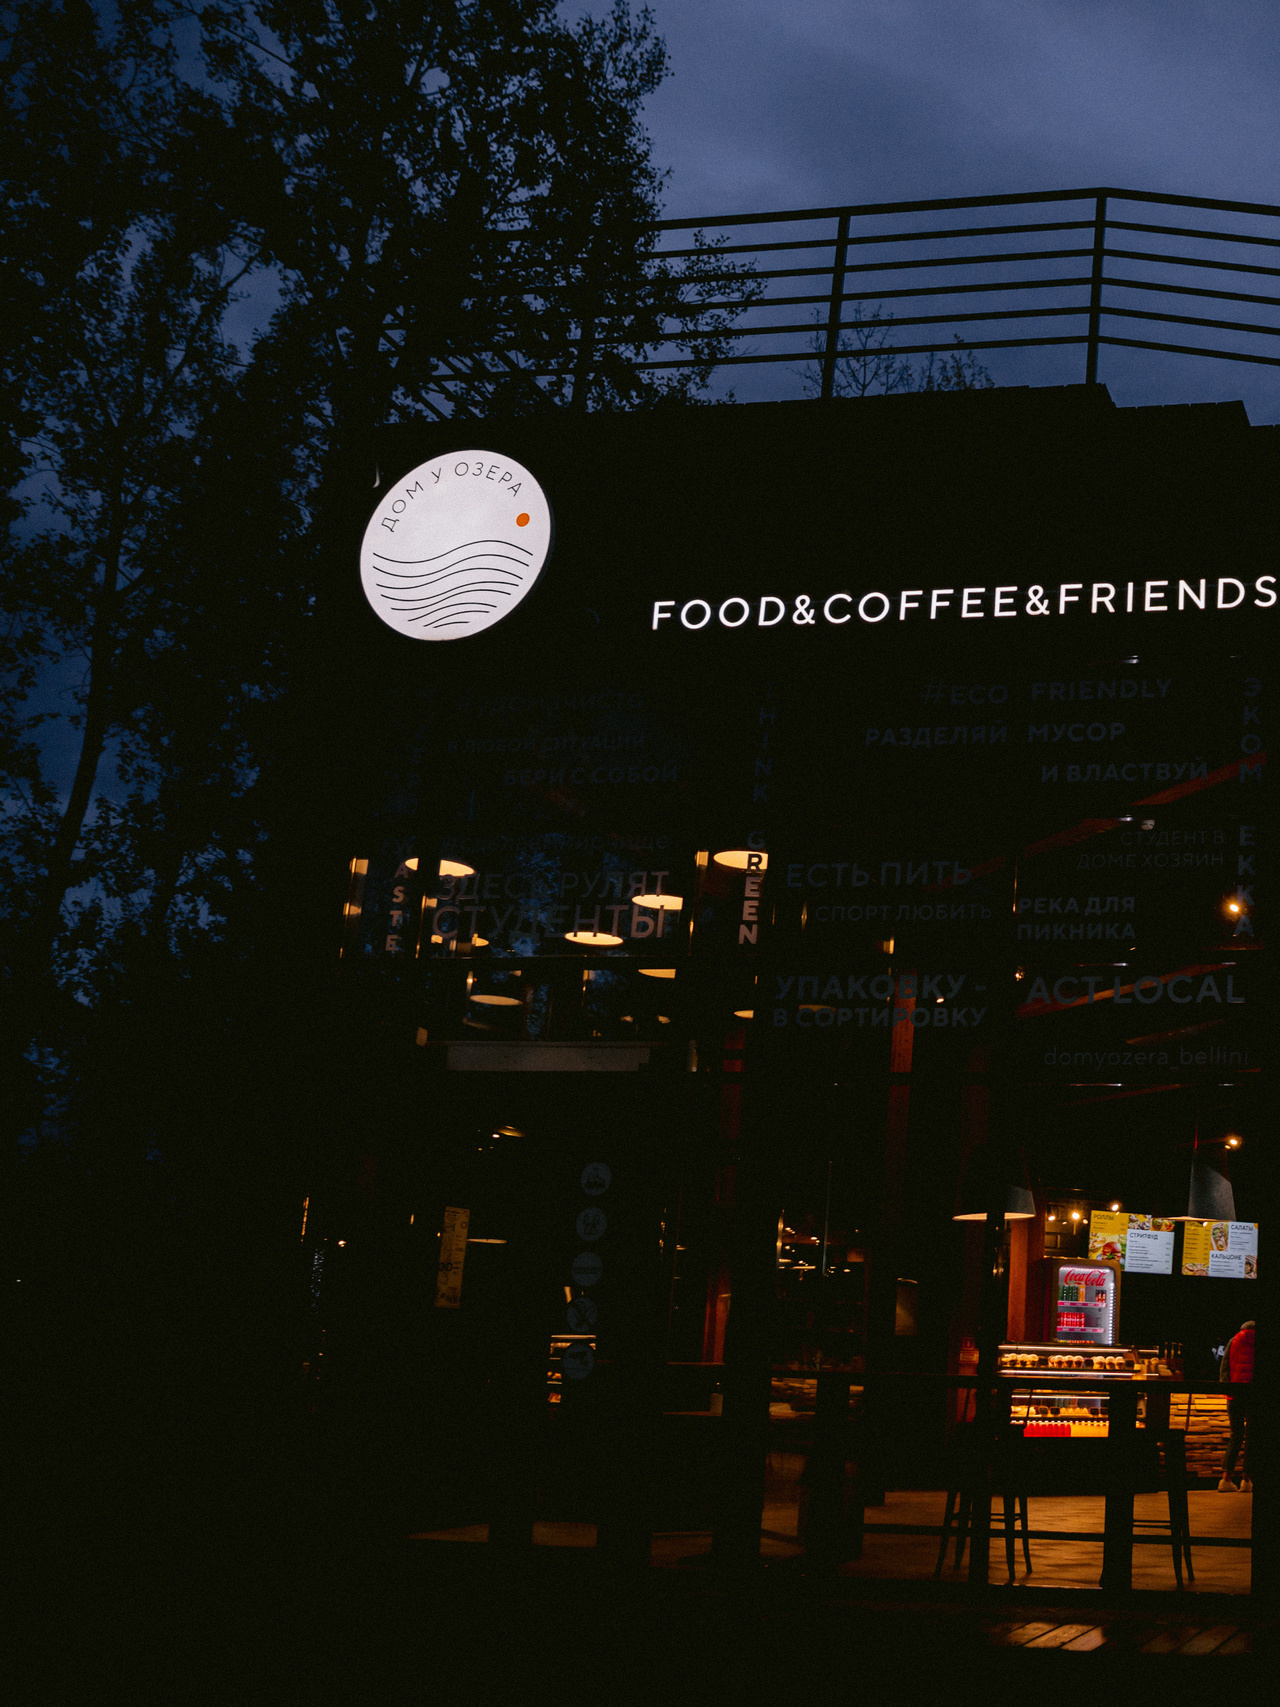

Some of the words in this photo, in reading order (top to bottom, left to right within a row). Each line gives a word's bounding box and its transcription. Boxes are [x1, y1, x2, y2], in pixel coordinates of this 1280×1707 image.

[381, 481, 424, 532] ДОМ
[431, 467, 442, 484] У
[454, 462, 522, 497] ОЗЕРА
[652, 575, 1278, 630] FOOD&COFFEE&FRIENDS
[1031, 677, 1172, 702] FRIENDLY
[864, 719, 1008, 749] РАЗДЕЛЯЙ
[1027, 722, 1126, 744] МУСОР
[1041, 764, 1058, 783] И
[1066, 756, 1208, 783] ВЛАСТВУЙ
[1120, 830, 1208, 848] СТУДЕНТ
[786, 861, 870, 888] ЕСТЬ
[880, 860, 973, 886] ПИТЬ
[1076, 853, 1137, 871] ДОМЕ
[1141, 852, 1224, 868] ХОЗЯИН
[559, 871, 670, 899] РУЛЯТ
[814, 904, 893, 923] СПОРТ
[894, 902, 993, 922] ЛЮБИТЬ
[1018, 897, 1080, 916] РЕКА
[1085, 896, 1136, 918] ДЛЯ
[432, 904, 665, 945] СТУДЕНТЫ
[1017, 921, 1136, 941] ПИКНИКА
[775, 974, 966, 1001] УПАКОВКУ
[1026, 976, 1105, 1006] ACT
[1113, 974, 1246, 1005] LOCAL
[773, 1009, 787, 1027] В
[796, 1006, 988, 1028] СОРТИРОВКУ
